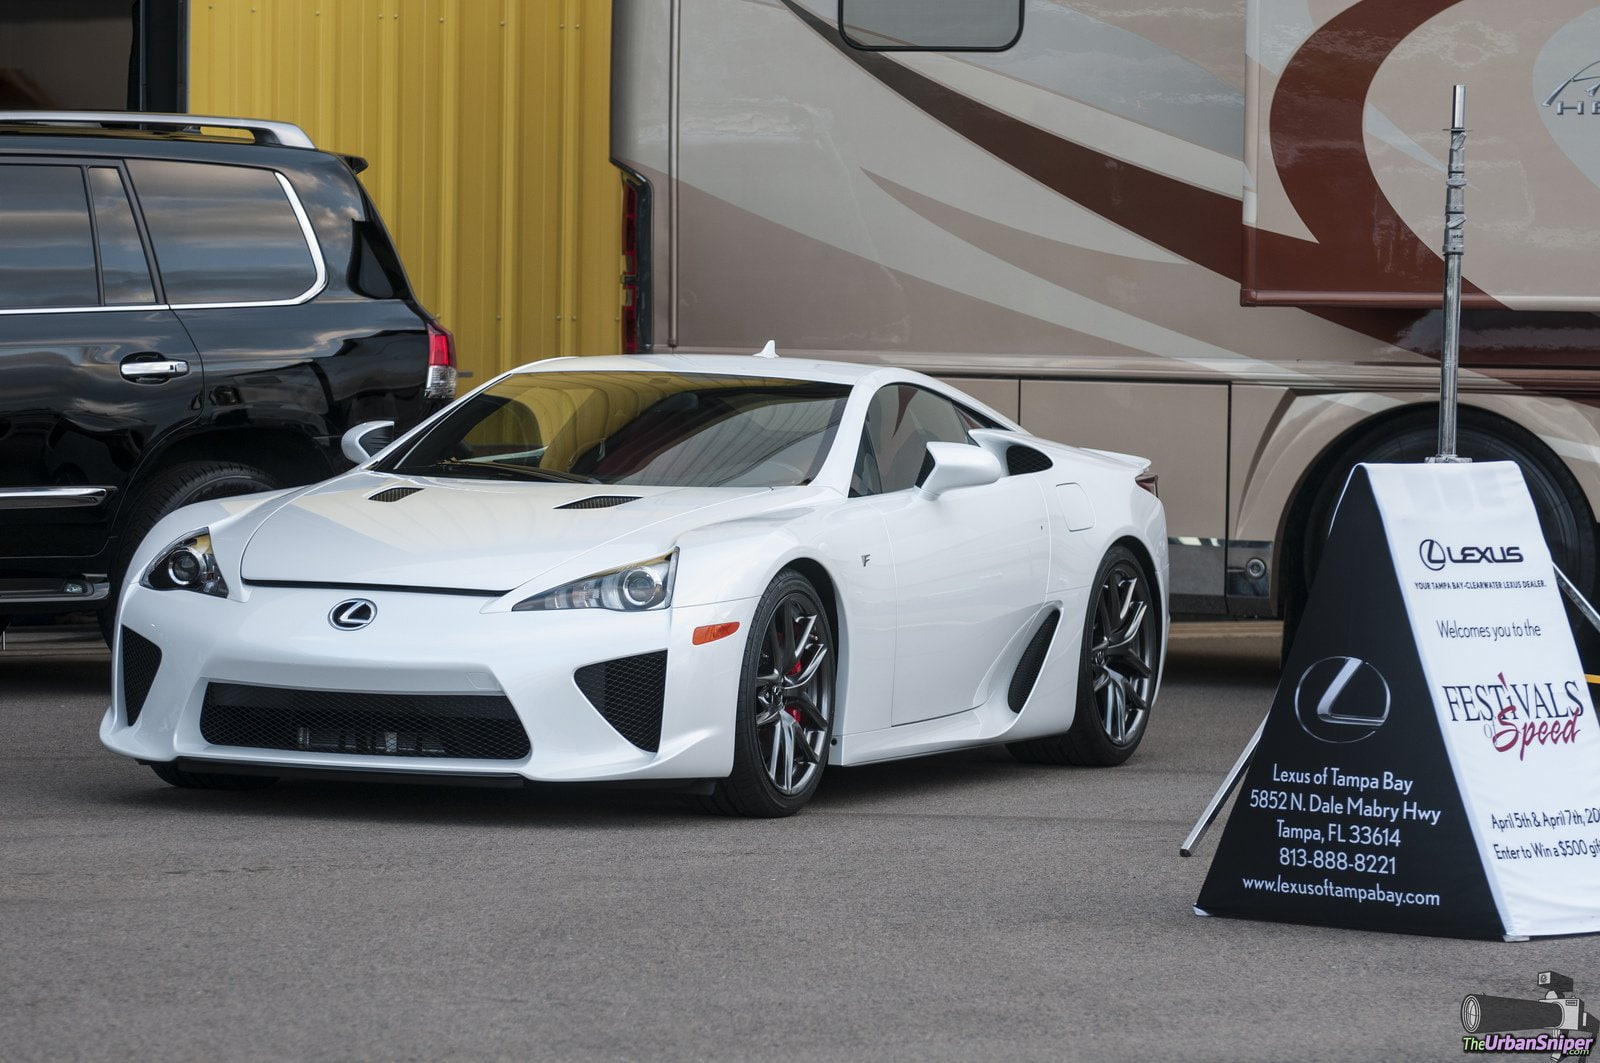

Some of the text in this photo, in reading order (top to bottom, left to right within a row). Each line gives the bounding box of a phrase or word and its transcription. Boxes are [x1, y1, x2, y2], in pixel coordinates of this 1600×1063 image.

[1446, 546, 1524, 563] LEXUS
[1414, 582, 1431, 590] YOUR
[1431, 582, 1452, 590] TAMPA
[1452, 581, 1502, 590] BAY-CLEARWATER
[1503, 581, 1522, 589] LEXUS
[1436, 618, 1541, 641] Welcomes you to the
[1483, 705, 1581, 762] of Speed
[1272, 763, 1414, 796] Lexus of Tampa Bay
[1249, 788, 1442, 826] 5852 N. Dale Mabry Hwy
[1491, 807, 1600, 832] April 5th & April 7th, 20
[1276, 819, 1401, 848] Tampa, FL 33614
[1279, 846, 1396, 875] 813-888-8221
[1493, 838, 1600, 860] Enter to Win a $500 gif
[1242, 874, 1440, 907] www.lexusoftampabay.com
